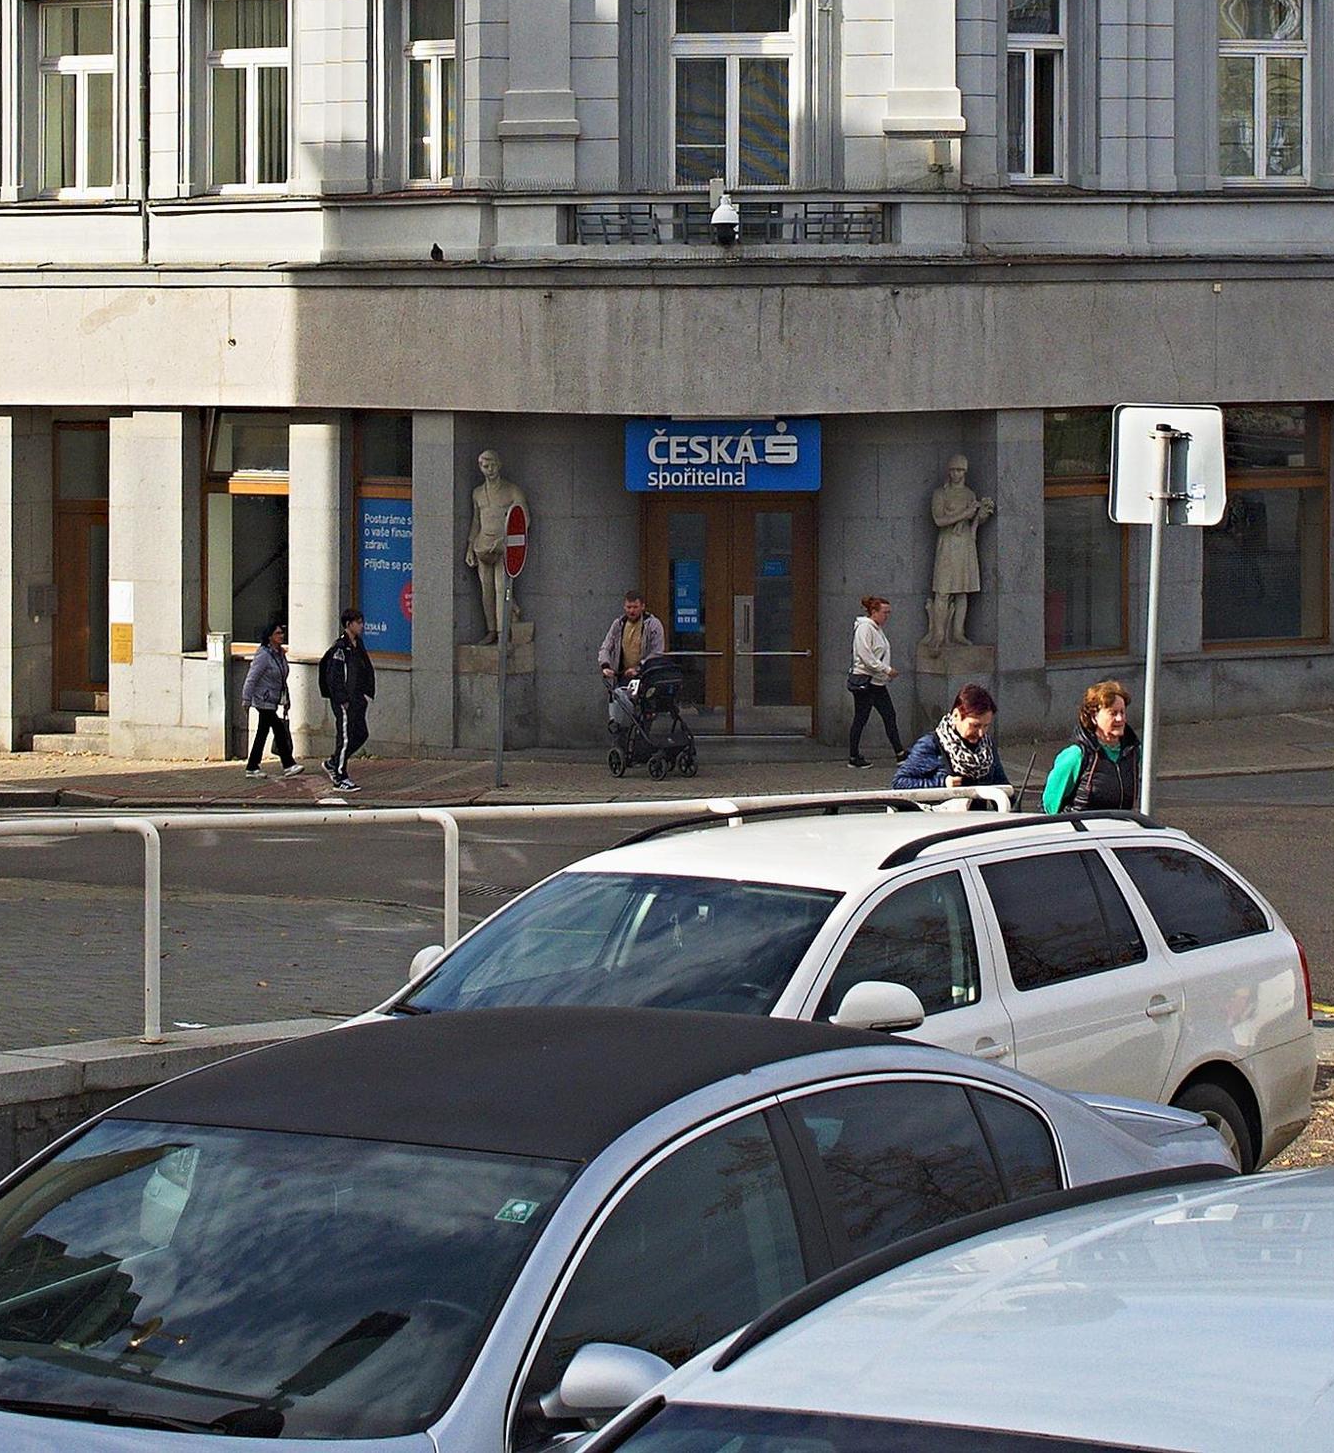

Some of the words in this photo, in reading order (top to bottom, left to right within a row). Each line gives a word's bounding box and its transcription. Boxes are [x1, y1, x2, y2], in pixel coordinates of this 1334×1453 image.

[648, 428, 758, 465] ČESKÁ
[647, 467, 746, 490] spořitelna
[364, 513, 407, 525] Postaráme
[364, 528, 371, 537] o
[391, 527, 413, 538] finan
[402, 562, 413, 572] po
